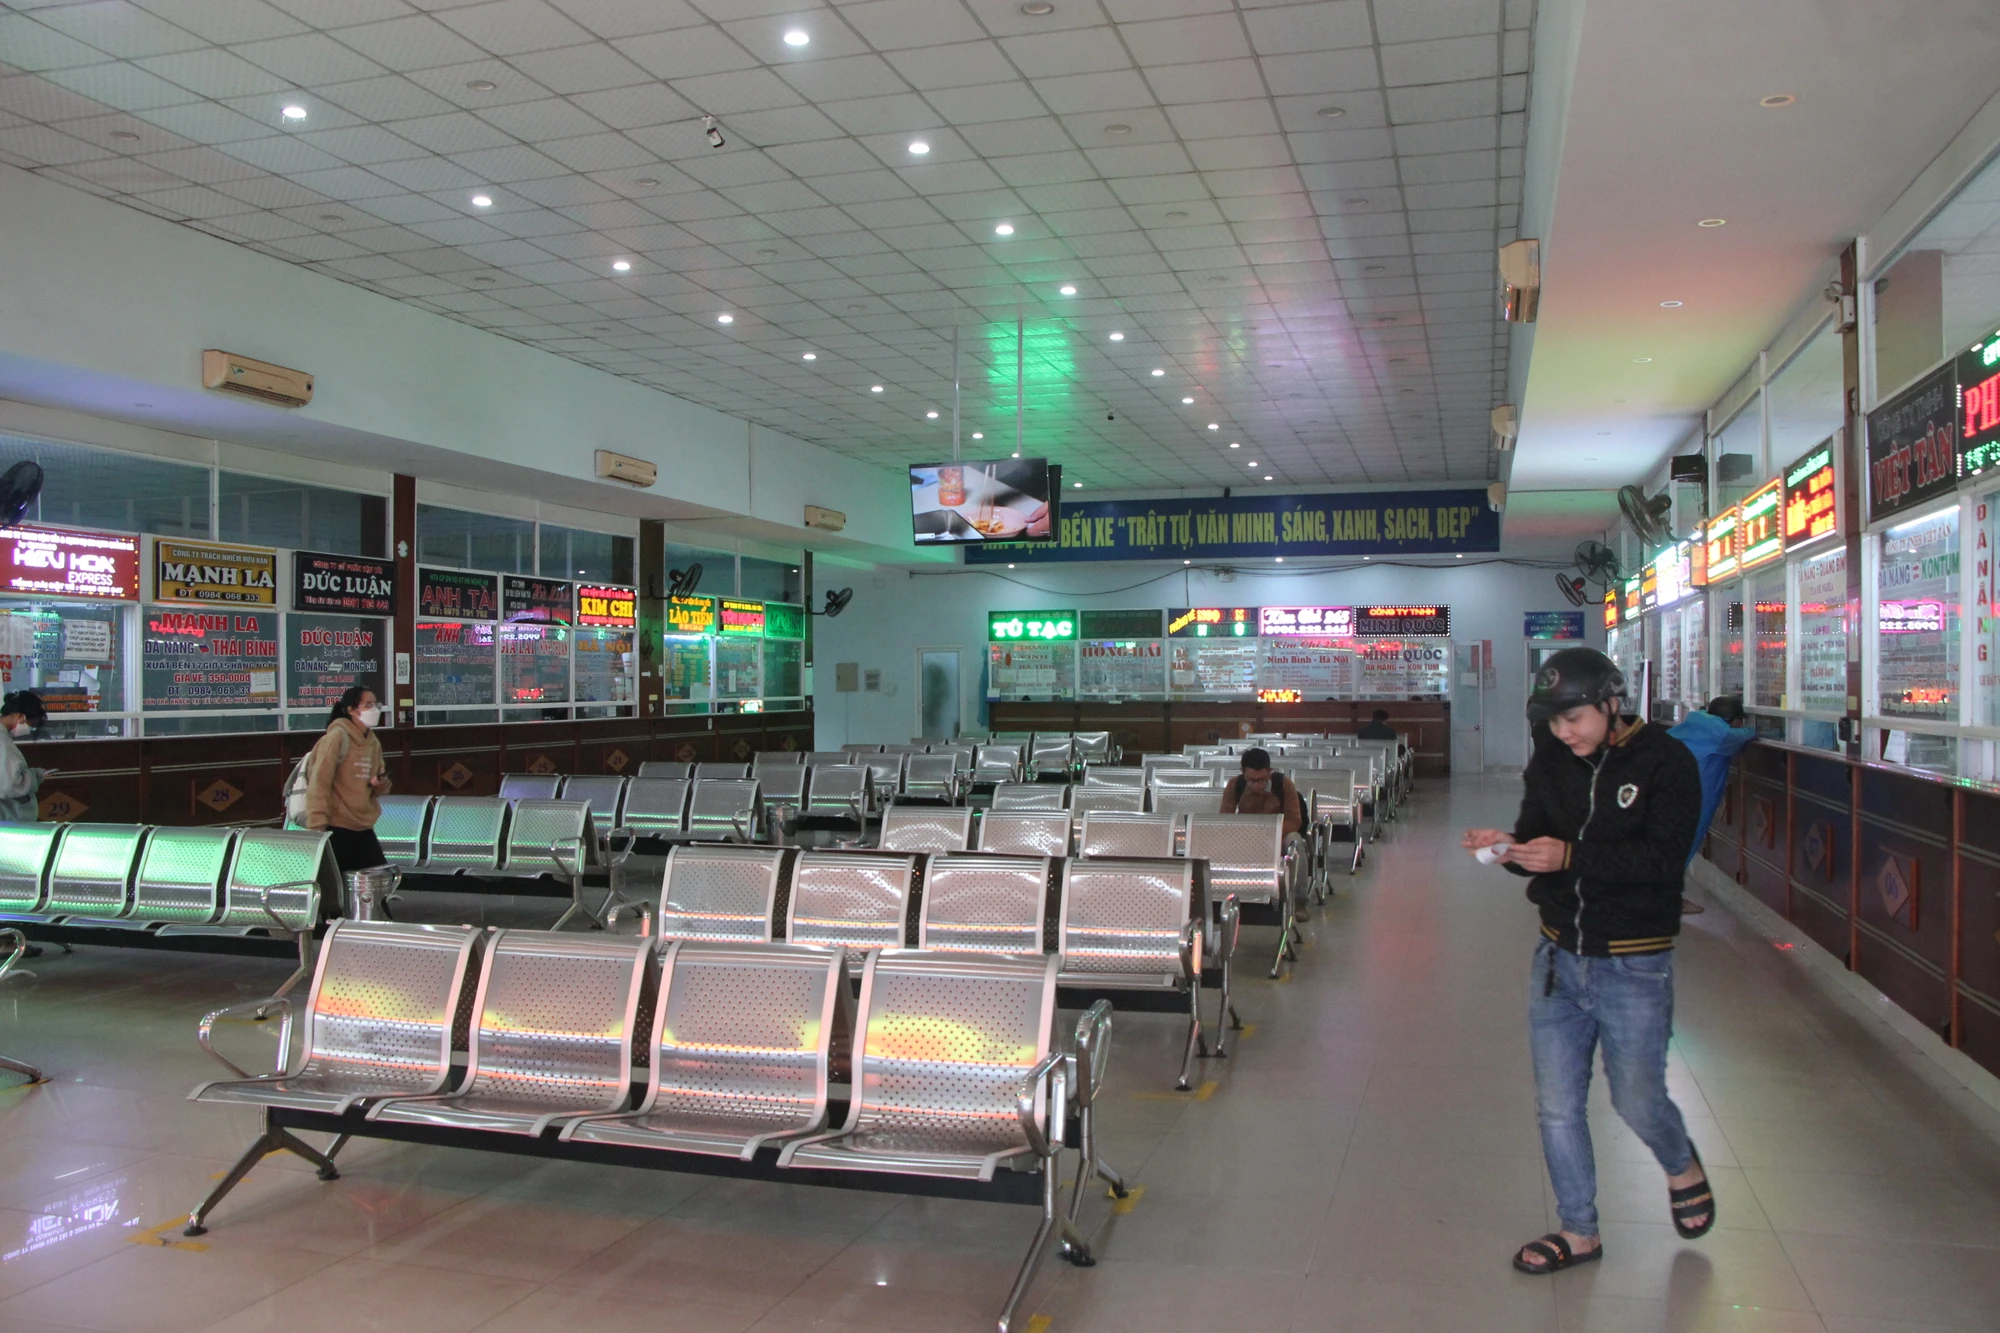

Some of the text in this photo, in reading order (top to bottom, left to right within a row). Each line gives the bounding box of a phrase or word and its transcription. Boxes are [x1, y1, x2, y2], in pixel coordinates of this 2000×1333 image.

[1873, 440, 1911, 506] VIỆT
[1914, 420, 1953, 488] TÂN
[1061, 510, 1092, 548] BẾN
[1094, 517, 1114, 546] XE
[1170, 509, 1193, 550] TỰ,
[1196, 508, 1228, 544] VĂN
[1232, 512, 1279, 546] MINH,
[1282, 504, 1330, 544] SÁNG,
[1332, 508, 1380, 542] XANH,
[1384, 508, 1433, 545] SẠCH,
[164, 562, 274, 588] MẠNH LA
[1889, 556, 1910, 587] NẴNG
[1921, 552, 1960, 580] KONTUM
[68, 571, 113, 586] EXPRESS
[303, 570, 392, 598] ĐỨC LUẬN
[421, 585, 460, 608] ANH
[468, 586, 496, 610] TÀI
[581, 598, 608, 616] KIM
[610, 600, 634, 617] CHI
[668, 606, 689, 624] LÀO
[691, 606, 713, 625] TIẾN
[1369, 608, 1396, 616] CÔNG
[234, 616, 260, 632] LA
[1298, 608, 1322, 624] Chi
[992, 618, 1072, 639] TÚ TẠC
[1360, 616, 1445, 634] MINH QUỐC
[301, 626, 373, 649] ĐỨC LUẬN
[435, 626, 460, 643] ANH
[144, 636, 277, 656] ĐÀ NẴNG THÁI BÌNH
[519, 640, 535, 654] LAI
[577, 638, 632, 654] HÀ NỘI
[1300, 640, 1320, 648] Chi
[1291, 655, 1311, 663] Bình
[1319, 655, 1330, 663] Hà
[1334, 655, 1349, 664] Nội
[1363, 646, 1442, 662] MINH QUỐC
[145, 659, 170, 670] XUẤT
[172, 660, 190, 670] BẾN
[192, 662, 202, 670] 17
[204, 660, 218, 670] GIỜ
[220, 662, 230, 670] 15
[295, 658, 306, 672] ĐÀ
[307, 656, 328, 672] NẴNG
[1377, 662, 1396, 670] NẴNG
[452, 768, 464, 781] 26
[212, 789, 230, 802] 28
[48, 802, 70, 817] 29
